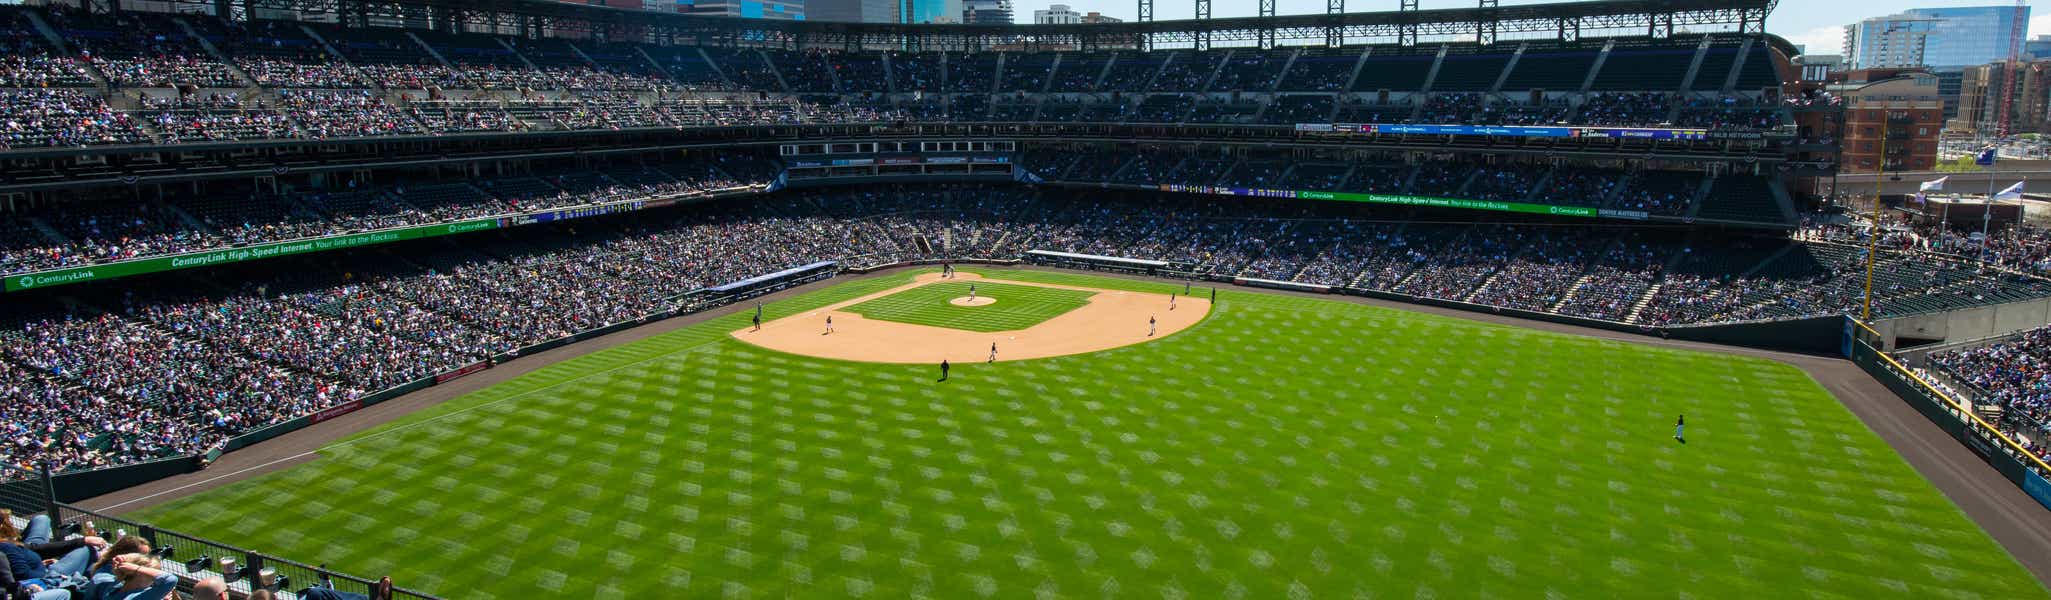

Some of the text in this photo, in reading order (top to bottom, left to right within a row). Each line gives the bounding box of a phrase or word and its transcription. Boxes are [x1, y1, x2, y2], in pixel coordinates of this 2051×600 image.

[1309, 192, 1334, 200] CenturyLink
[1369, 194, 1398, 203] CenturyLink
[1558, 207, 1589, 216] CenturyLink
[457, 222, 489, 231] CenturyLink
[172, 252, 227, 267] CenturyLink
[228, 245, 279, 260] High-Speed
[315, 240, 332, 249] Your
[334, 238, 347, 247] link
[357, 236, 369, 244] the
[36, 270, 95, 284] CenturyLink
